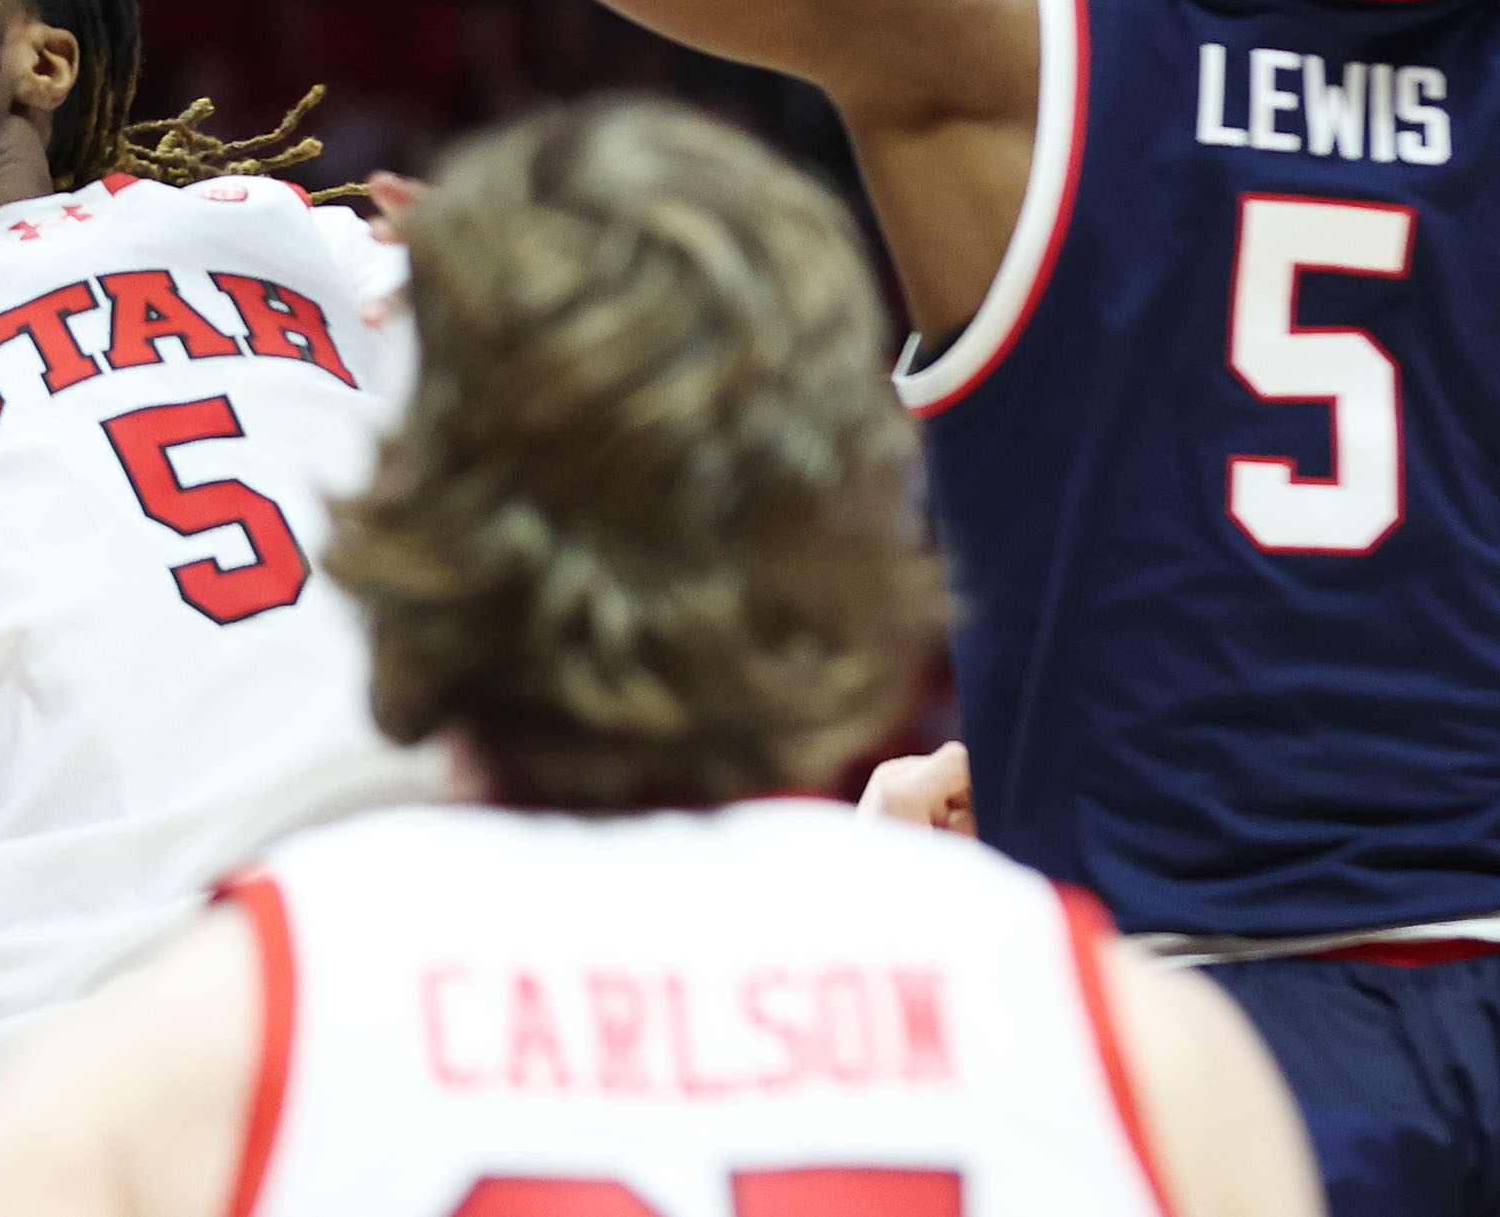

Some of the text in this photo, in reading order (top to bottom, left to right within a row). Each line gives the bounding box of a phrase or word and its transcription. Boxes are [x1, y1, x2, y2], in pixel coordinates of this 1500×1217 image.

[1196, 43, 1452, 166] LEWIS
[1226, 191, 1418, 557] 5
[99, 394, 312, 626] 5
[418, 965, 957, 1097] CARLSON
